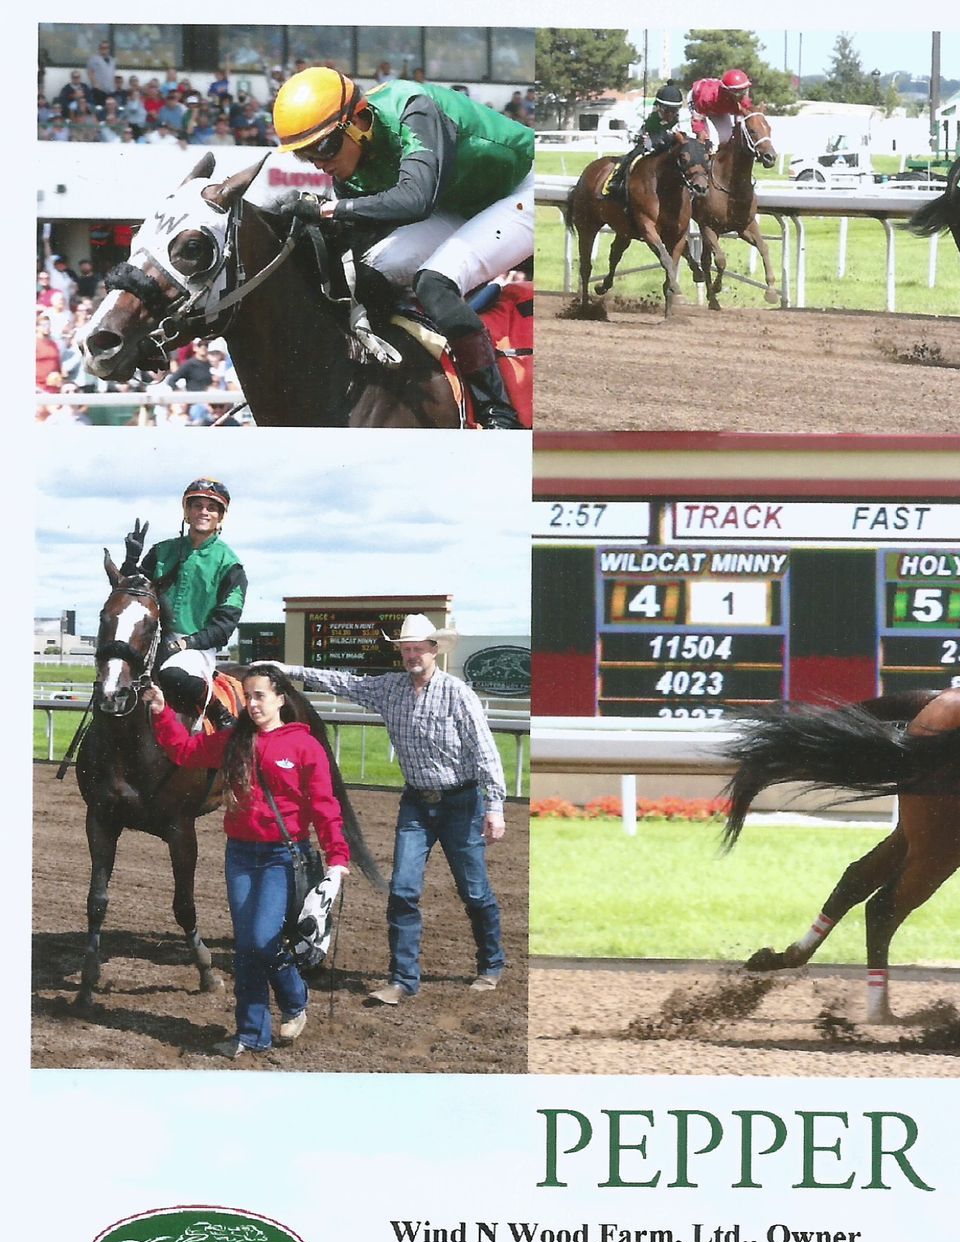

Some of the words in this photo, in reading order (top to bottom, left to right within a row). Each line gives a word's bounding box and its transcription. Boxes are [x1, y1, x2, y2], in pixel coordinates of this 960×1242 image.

[549, 505, 607, 528] 2:57
[682, 506, 785, 531] TRACK
[851, 508, 932, 532] FAST
[601, 553, 705, 574] WILDCAT
[711, 554, 787, 575] MINNY
[628, 589, 661, 618] 4
[722, 593, 735, 616] 1
[912, 588, 944, 621] 5
[316, 624, 322, 633] 7
[316, 639, 322, 647] 4
[649, 636, 732, 660] 11504
[316, 654, 322, 662] 5
[655, 671, 724, 695] 4023
